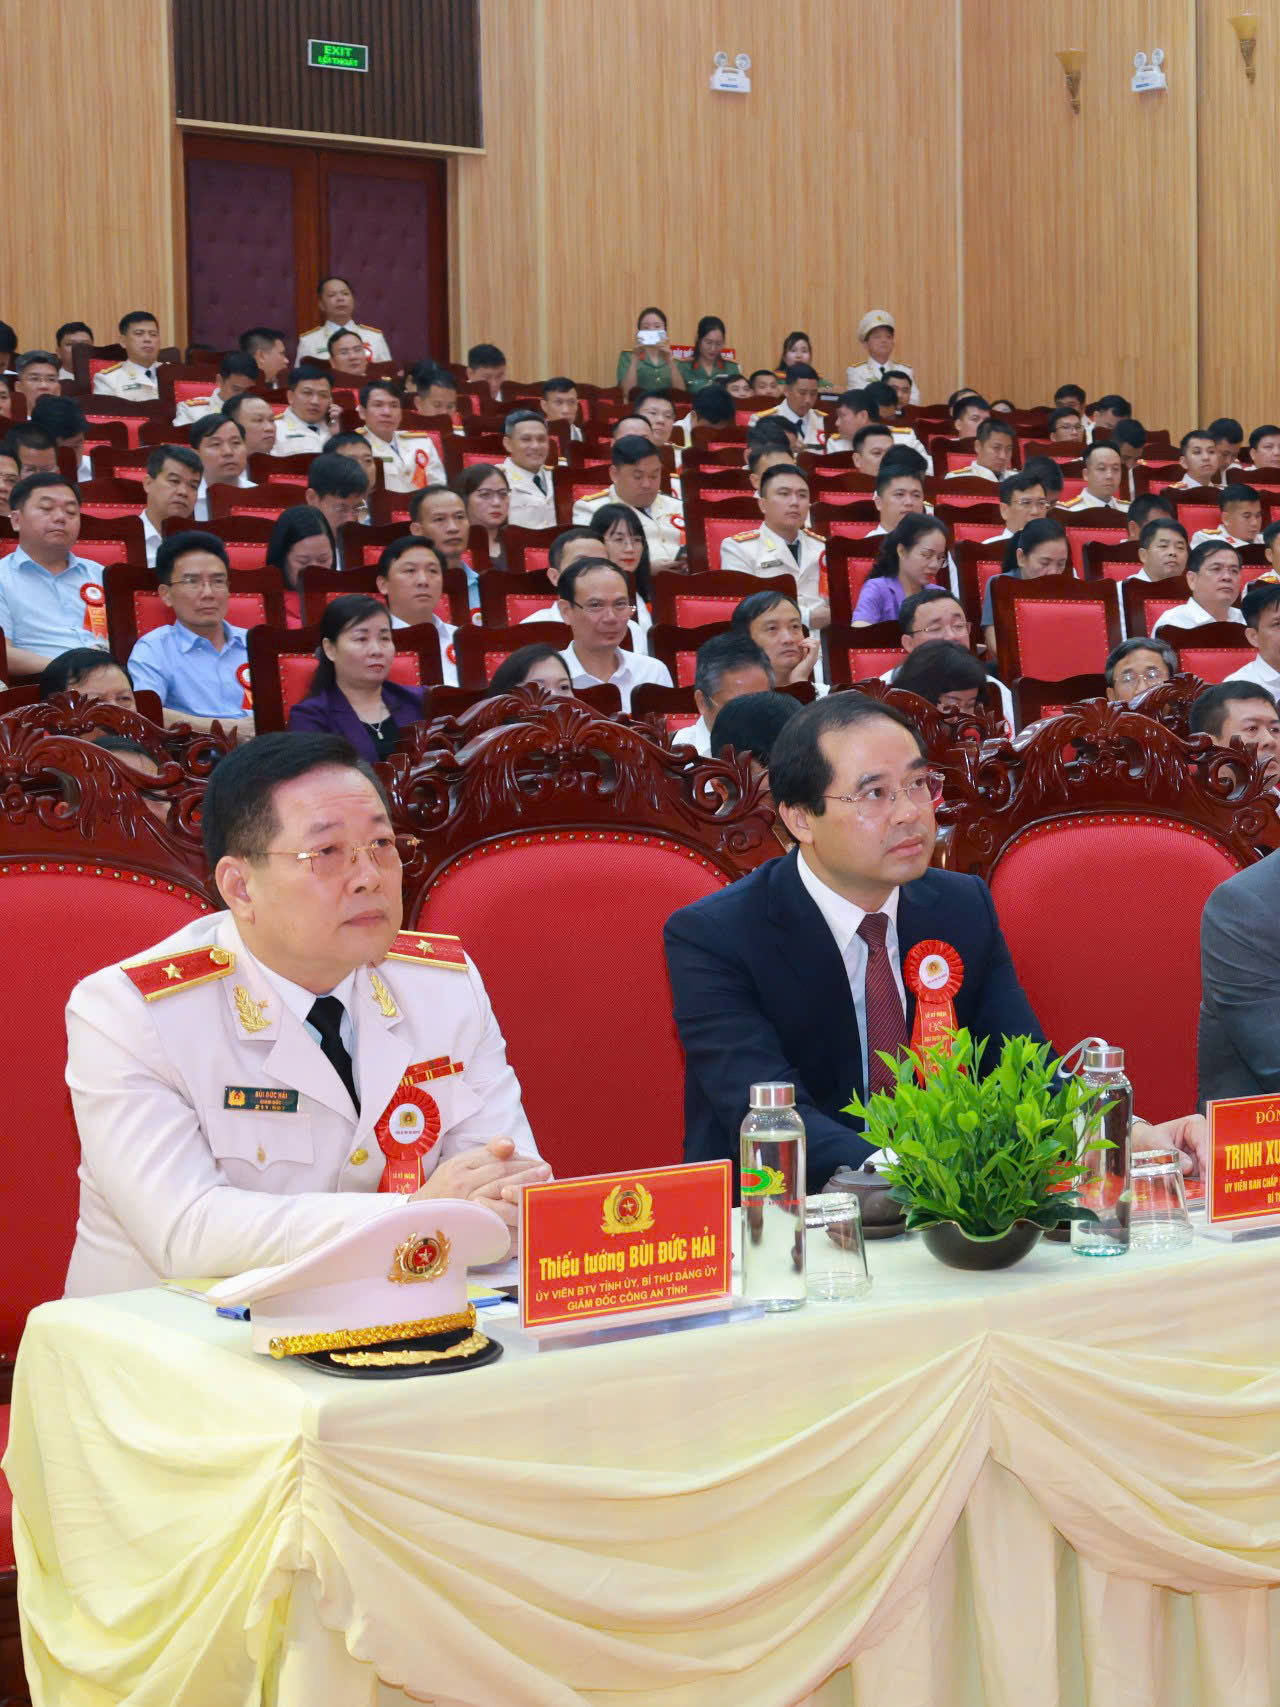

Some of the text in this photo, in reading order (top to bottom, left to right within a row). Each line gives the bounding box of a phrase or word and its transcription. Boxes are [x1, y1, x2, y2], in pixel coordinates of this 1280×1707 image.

[324, 45, 352, 57] EXIT
[1224, 1141, 1263, 1174] TRỊNH
[539, 1226, 716, 1281] Thiếu tướng BÙI ĐỨC HẢI
[552, 1285, 575, 1300] VIÊN
[578, 1285, 597, 1297] BTV
[641, 1273, 652, 1287] BÍ
[654, 1272, 674, 1285] THƯ
[675, 1267, 702, 1282] ĐẢNG
[567, 1283, 688, 1312] GIÁM ĐỐC CÔNG AN TỈNH
